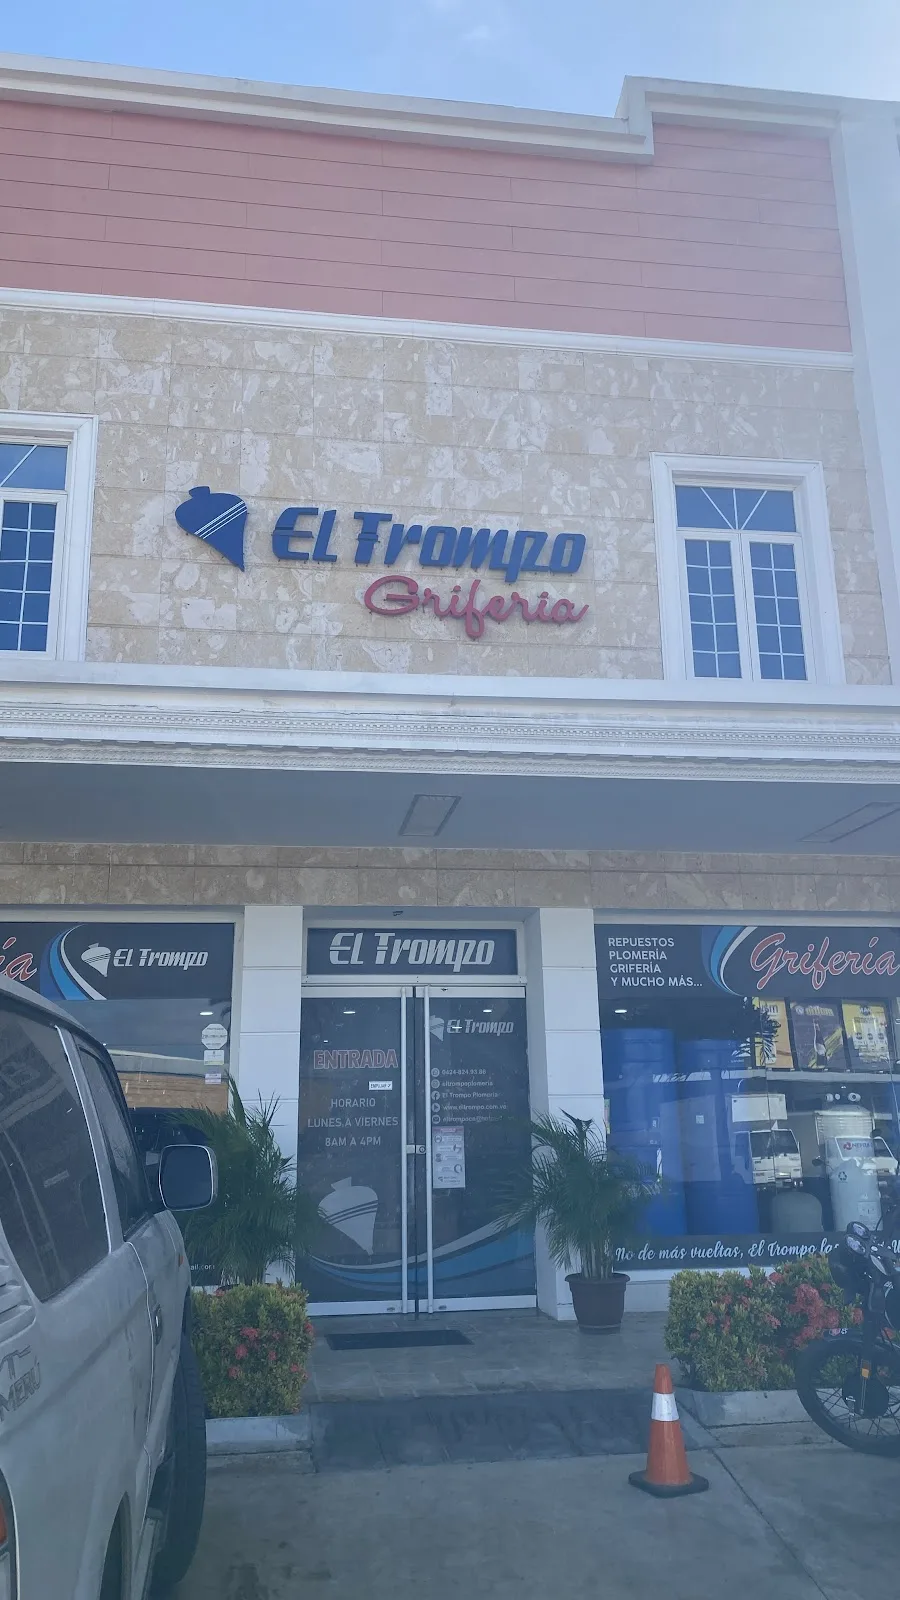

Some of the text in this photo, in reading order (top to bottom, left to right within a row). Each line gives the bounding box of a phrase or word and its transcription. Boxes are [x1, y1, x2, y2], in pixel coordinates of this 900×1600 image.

[353, 510, 588, 583] Trompo
[607, 937, 675, 947] REPUESTOS
[138, 948, 209, 971] Trompo
[374, 932, 496, 972] Trompo
[608, 948, 668, 960] PLOMERÍA
[609, 961, 662, 974] GRIFERÍA
[749, 931, 900, 990] Grifería
[610, 977, 619, 987] Y
[621, 976, 665, 987] MUCHO
[463, 1018, 515, 1037] Trompo
[313, 1048, 399, 1070] ENTRADA
[330, 1097, 376, 1108] HORARIO
[307, 1116, 399, 1128] LUNES A VIERNES
[325, 1136, 381, 1147] 8AM A 4PM
[615, 1246, 634, 1262] No
[658, 1245, 687, 1260] más
[690, 1240, 744, 1260] vueltas,
[747, 1239, 765, 1257] El
[767, 1240, 817, 1259] Trompo
